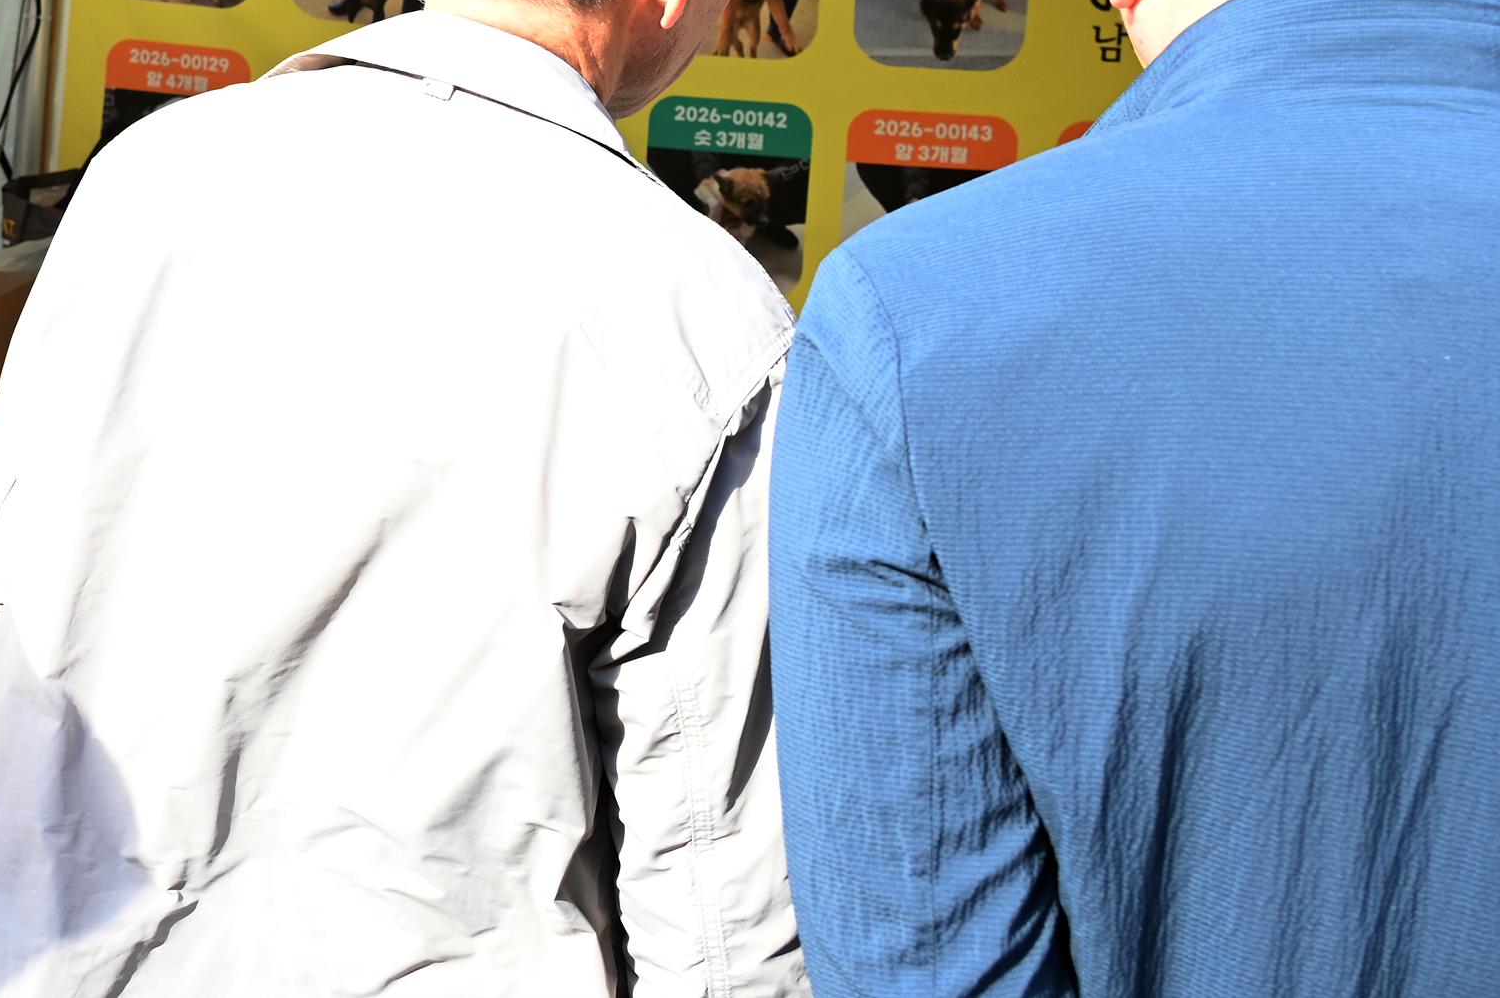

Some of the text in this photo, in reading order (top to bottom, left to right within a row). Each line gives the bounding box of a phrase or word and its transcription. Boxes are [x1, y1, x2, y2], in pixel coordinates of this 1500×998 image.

[129, 48, 231, 73] 2026-00129
[166, 73, 209, 92] 4개월
[674, 105, 789, 129] 2026-00142
[715, 131, 765, 151] 3개월
[874, 118, 994, 142] 2026-00143
[895, 143, 969, 165] 암 3개월
